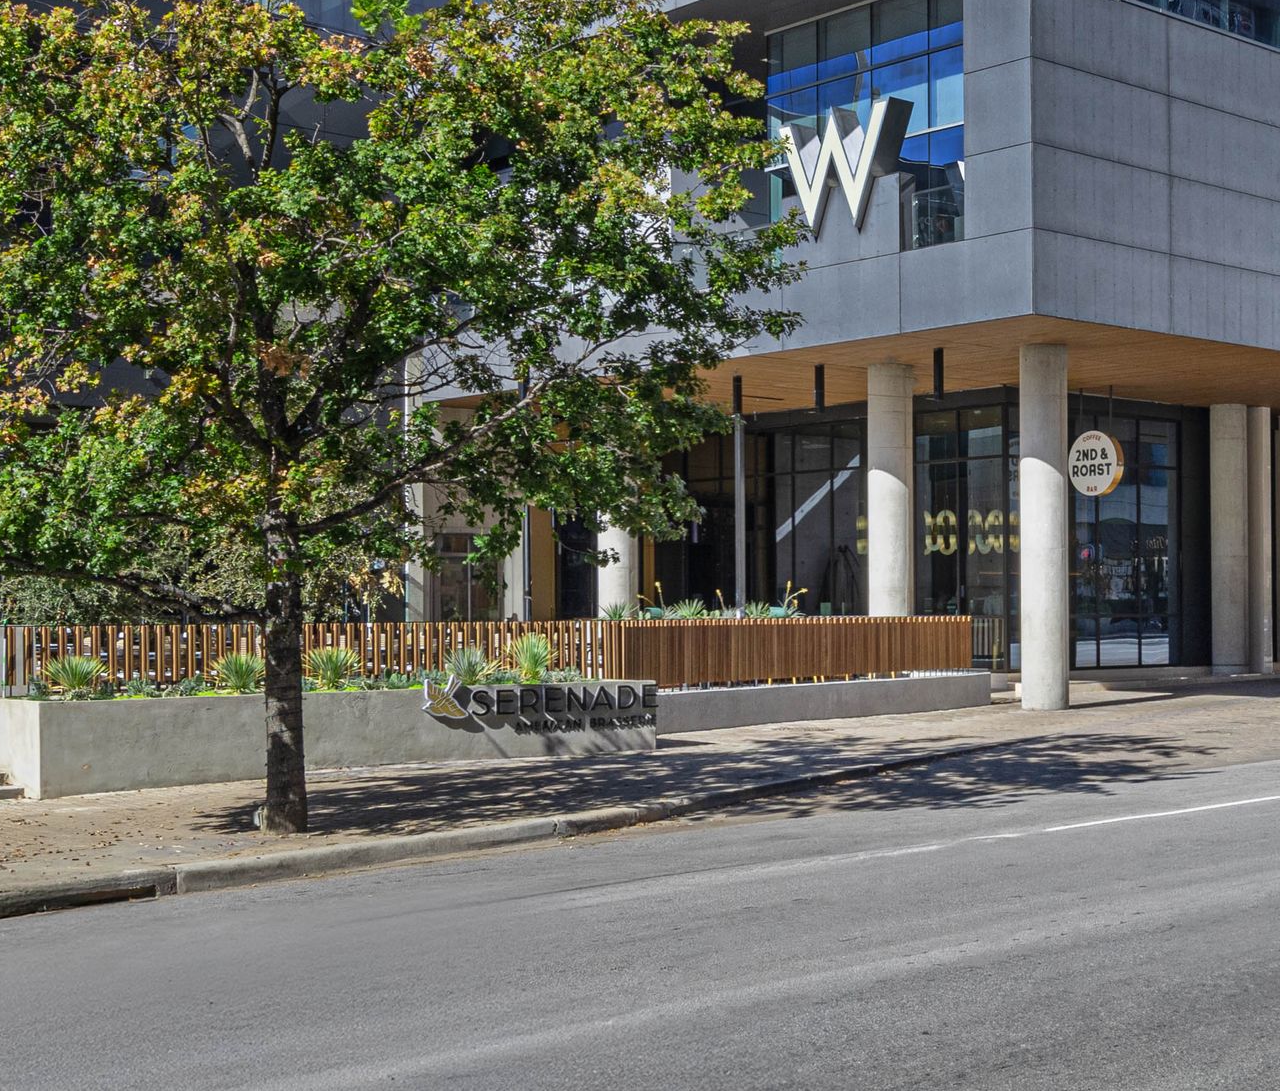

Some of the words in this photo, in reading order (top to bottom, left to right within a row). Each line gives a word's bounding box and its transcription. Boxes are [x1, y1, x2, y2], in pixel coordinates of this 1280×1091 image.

[778, 96, 914, 242] W
[1082, 434, 1102, 443] COFFEE
[1075, 448, 1098, 462] 2ND
[1100, 447, 1109, 460] &
[1072, 463, 1112, 477] ROAST
[471, 683, 659, 717] SERENADE
